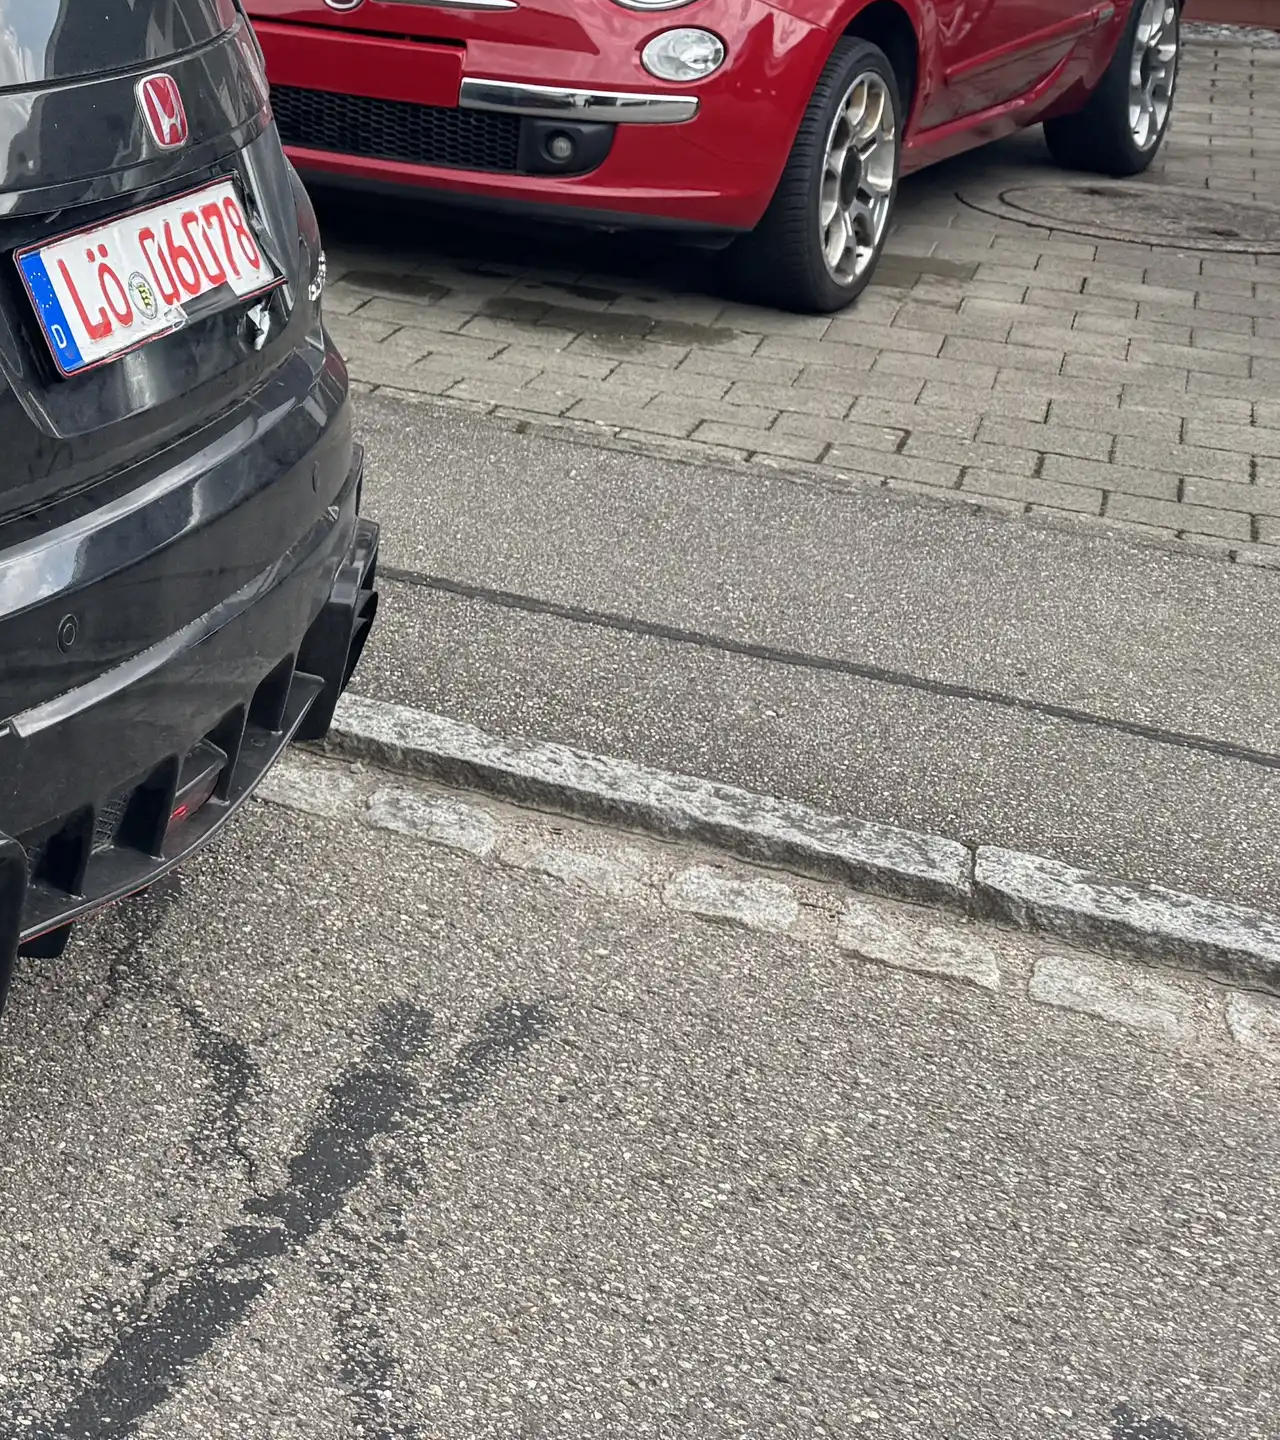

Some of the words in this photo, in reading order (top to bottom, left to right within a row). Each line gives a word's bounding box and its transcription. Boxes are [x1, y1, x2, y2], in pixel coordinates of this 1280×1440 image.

[57, 244, 133, 341] LÖ
[137, 196, 261, 306] 06078
[49, 324, 68, 350] D
